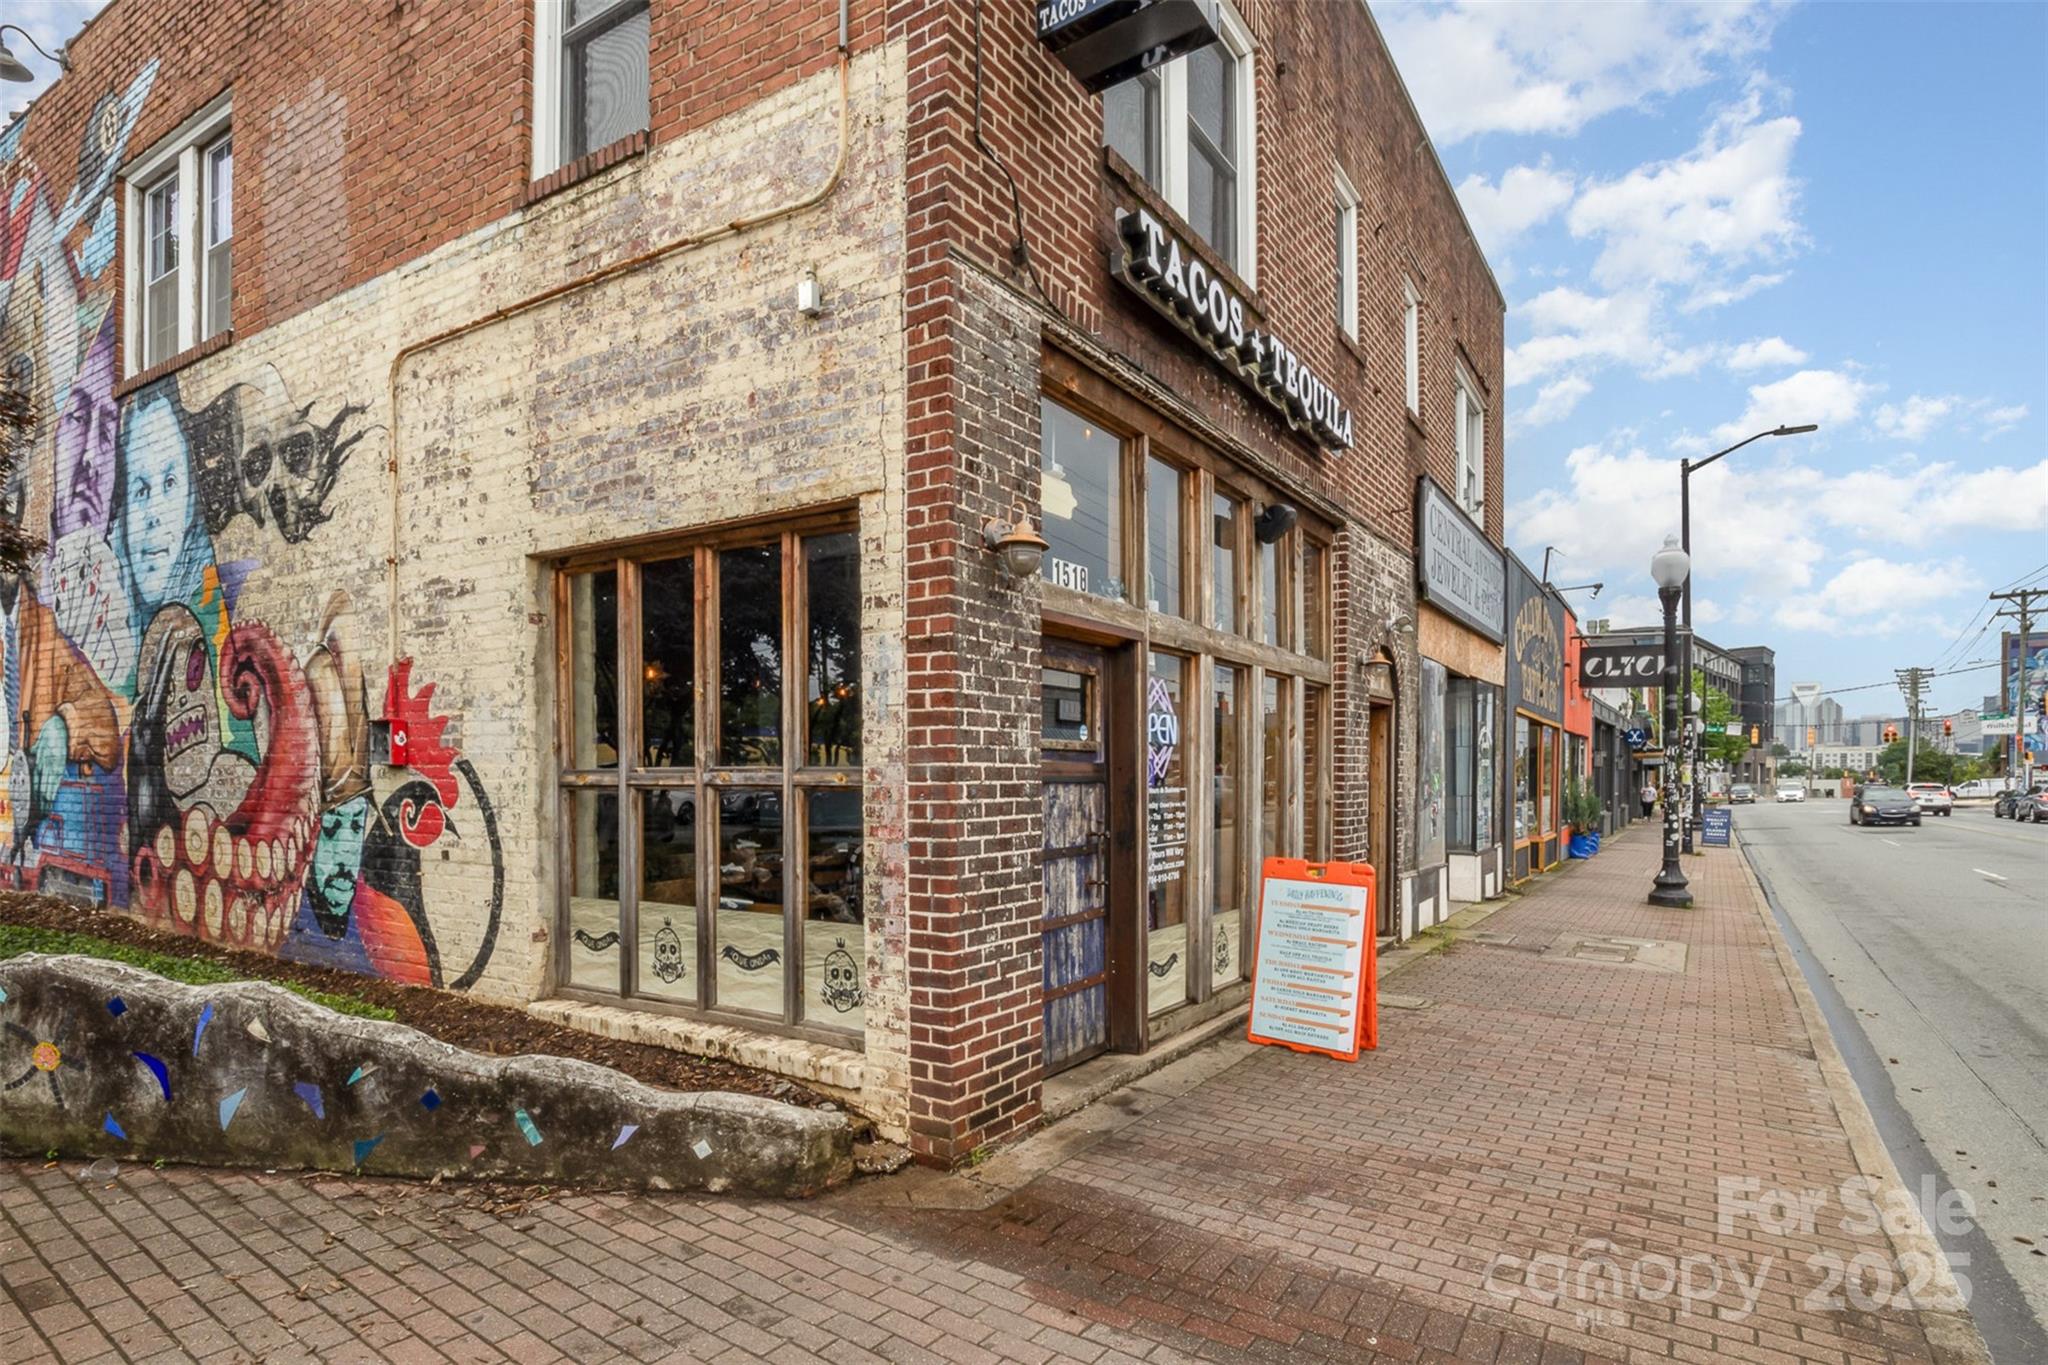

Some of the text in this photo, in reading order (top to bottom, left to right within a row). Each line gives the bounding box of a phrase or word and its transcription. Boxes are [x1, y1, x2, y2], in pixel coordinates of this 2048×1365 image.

[1040, 0, 1086, 30] TACOS
[1140, 209, 1244, 347] TACOS
[1270, 335, 1355, 449] TEQUILA
[1429, 503, 1472, 569] CENTRAL
[1055, 561, 1087, 592] 1518
[1431, 547, 1473, 606] JEWELRY
[1148, 712, 1178, 745] PEN
